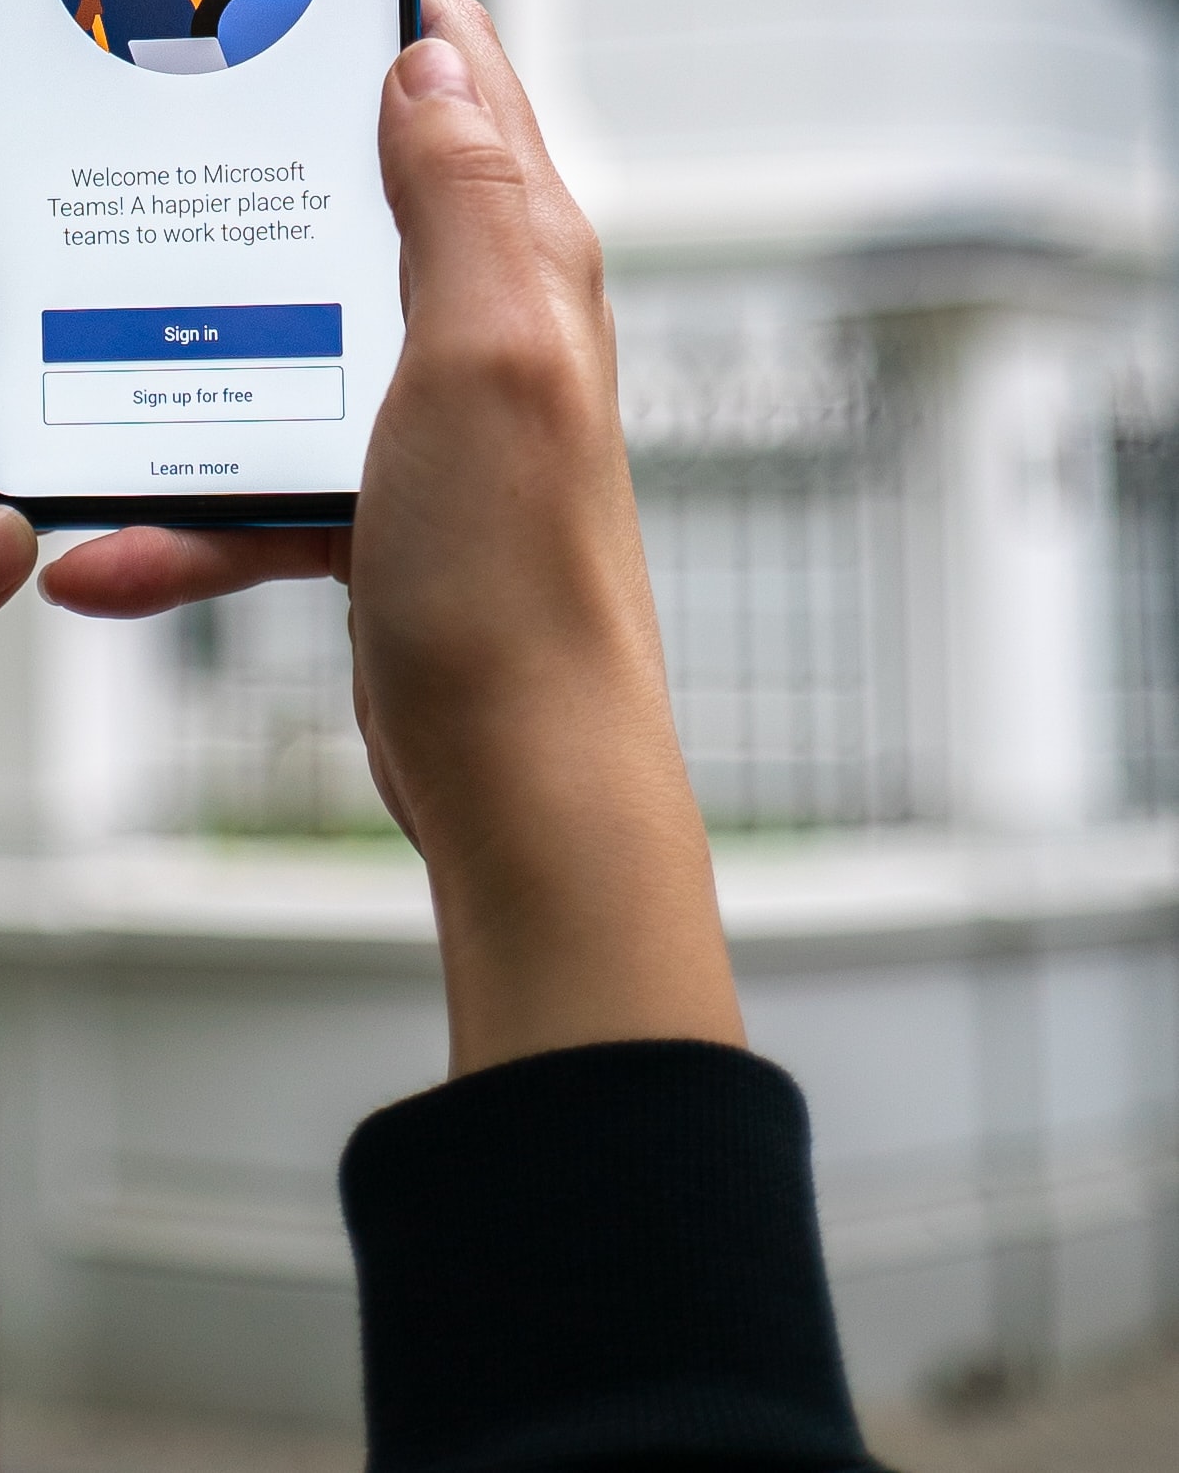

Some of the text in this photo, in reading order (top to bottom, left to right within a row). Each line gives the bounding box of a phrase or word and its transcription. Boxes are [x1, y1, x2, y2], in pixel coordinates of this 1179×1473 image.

[71, 161, 305, 187] Welcome to Microsoft
[47, 190, 332, 218] Teams! A happier place for
[63, 220, 315, 246] teams to work together.
[164, 324, 219, 344] Sign in
[132, 388, 253, 407] Sign up for free
[150, 461, 240, 476] Learn more
